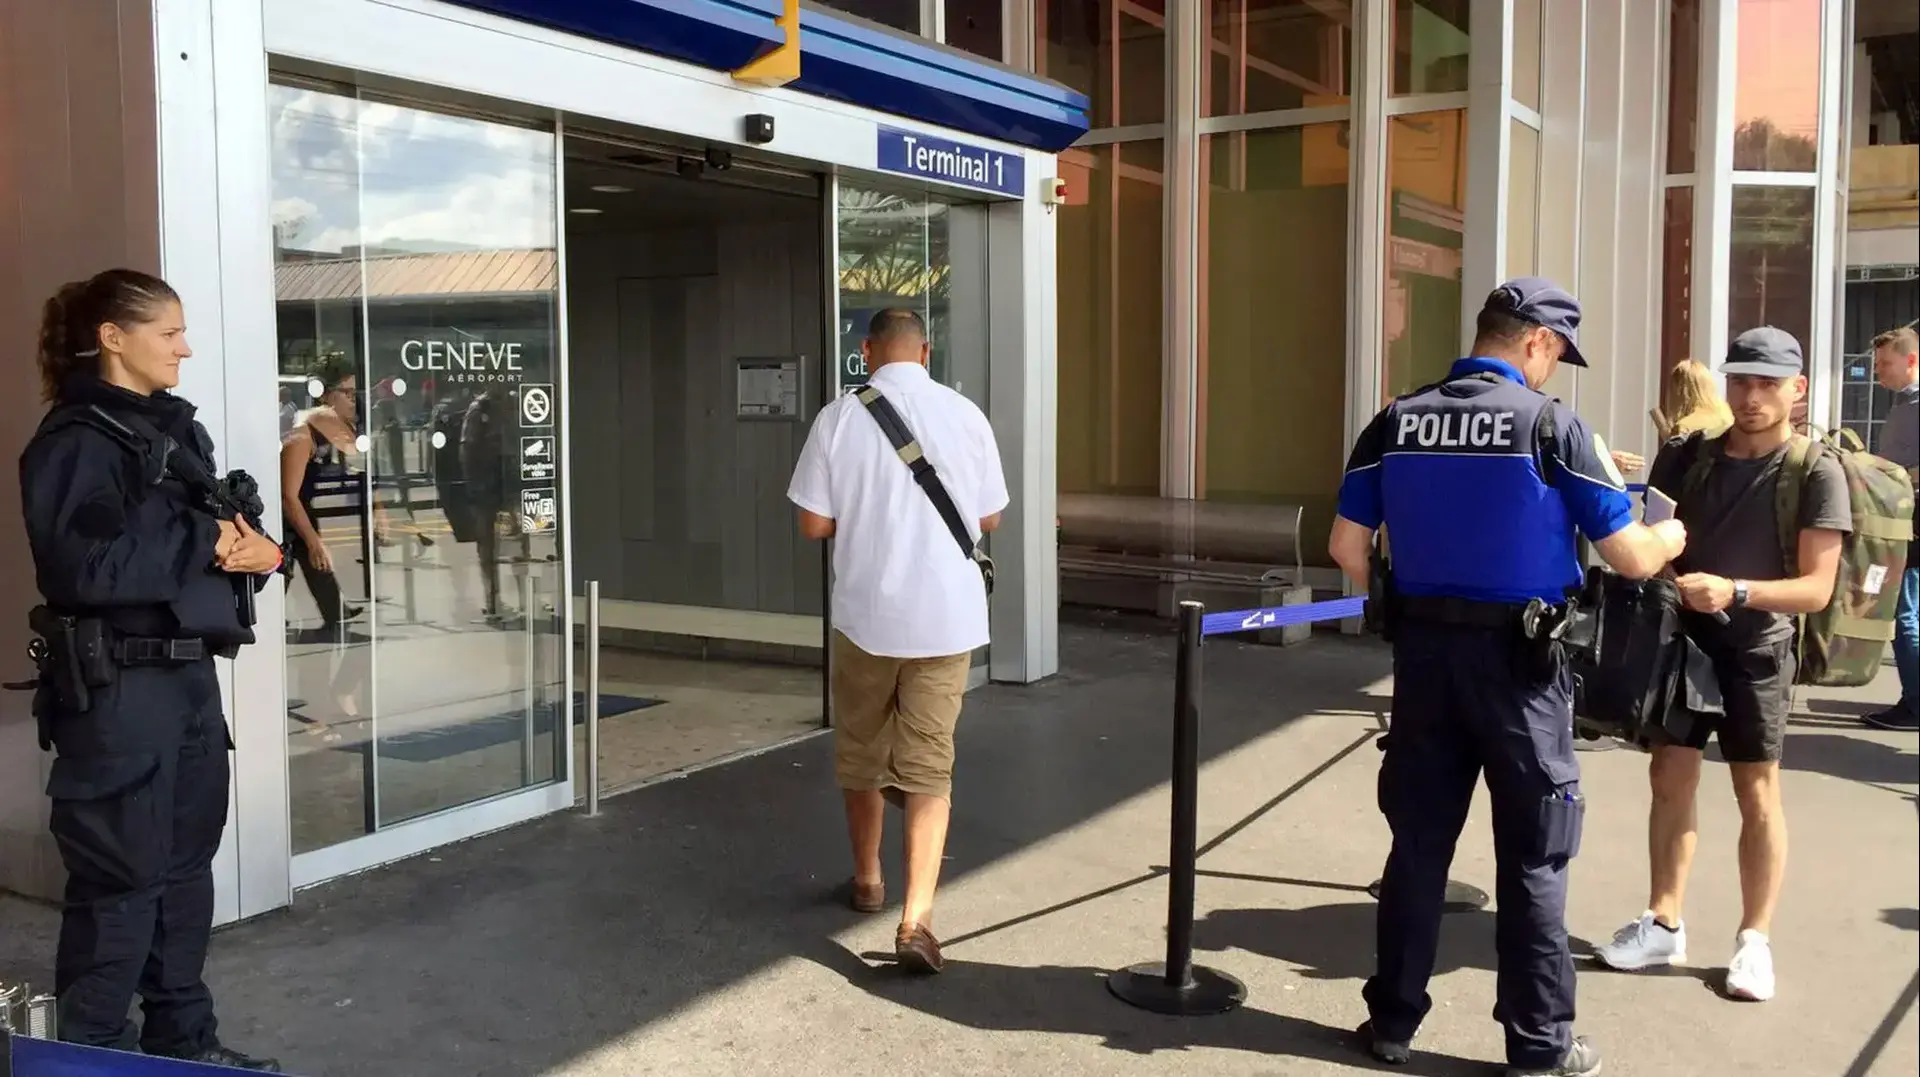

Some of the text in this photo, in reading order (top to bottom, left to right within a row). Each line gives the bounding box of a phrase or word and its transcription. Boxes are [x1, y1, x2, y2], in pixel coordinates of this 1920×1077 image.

[903, 136, 1004, 186] Terminal 1
[401, 340, 523, 370] GENEVE
[1397, 412, 1514, 446] POLICE
